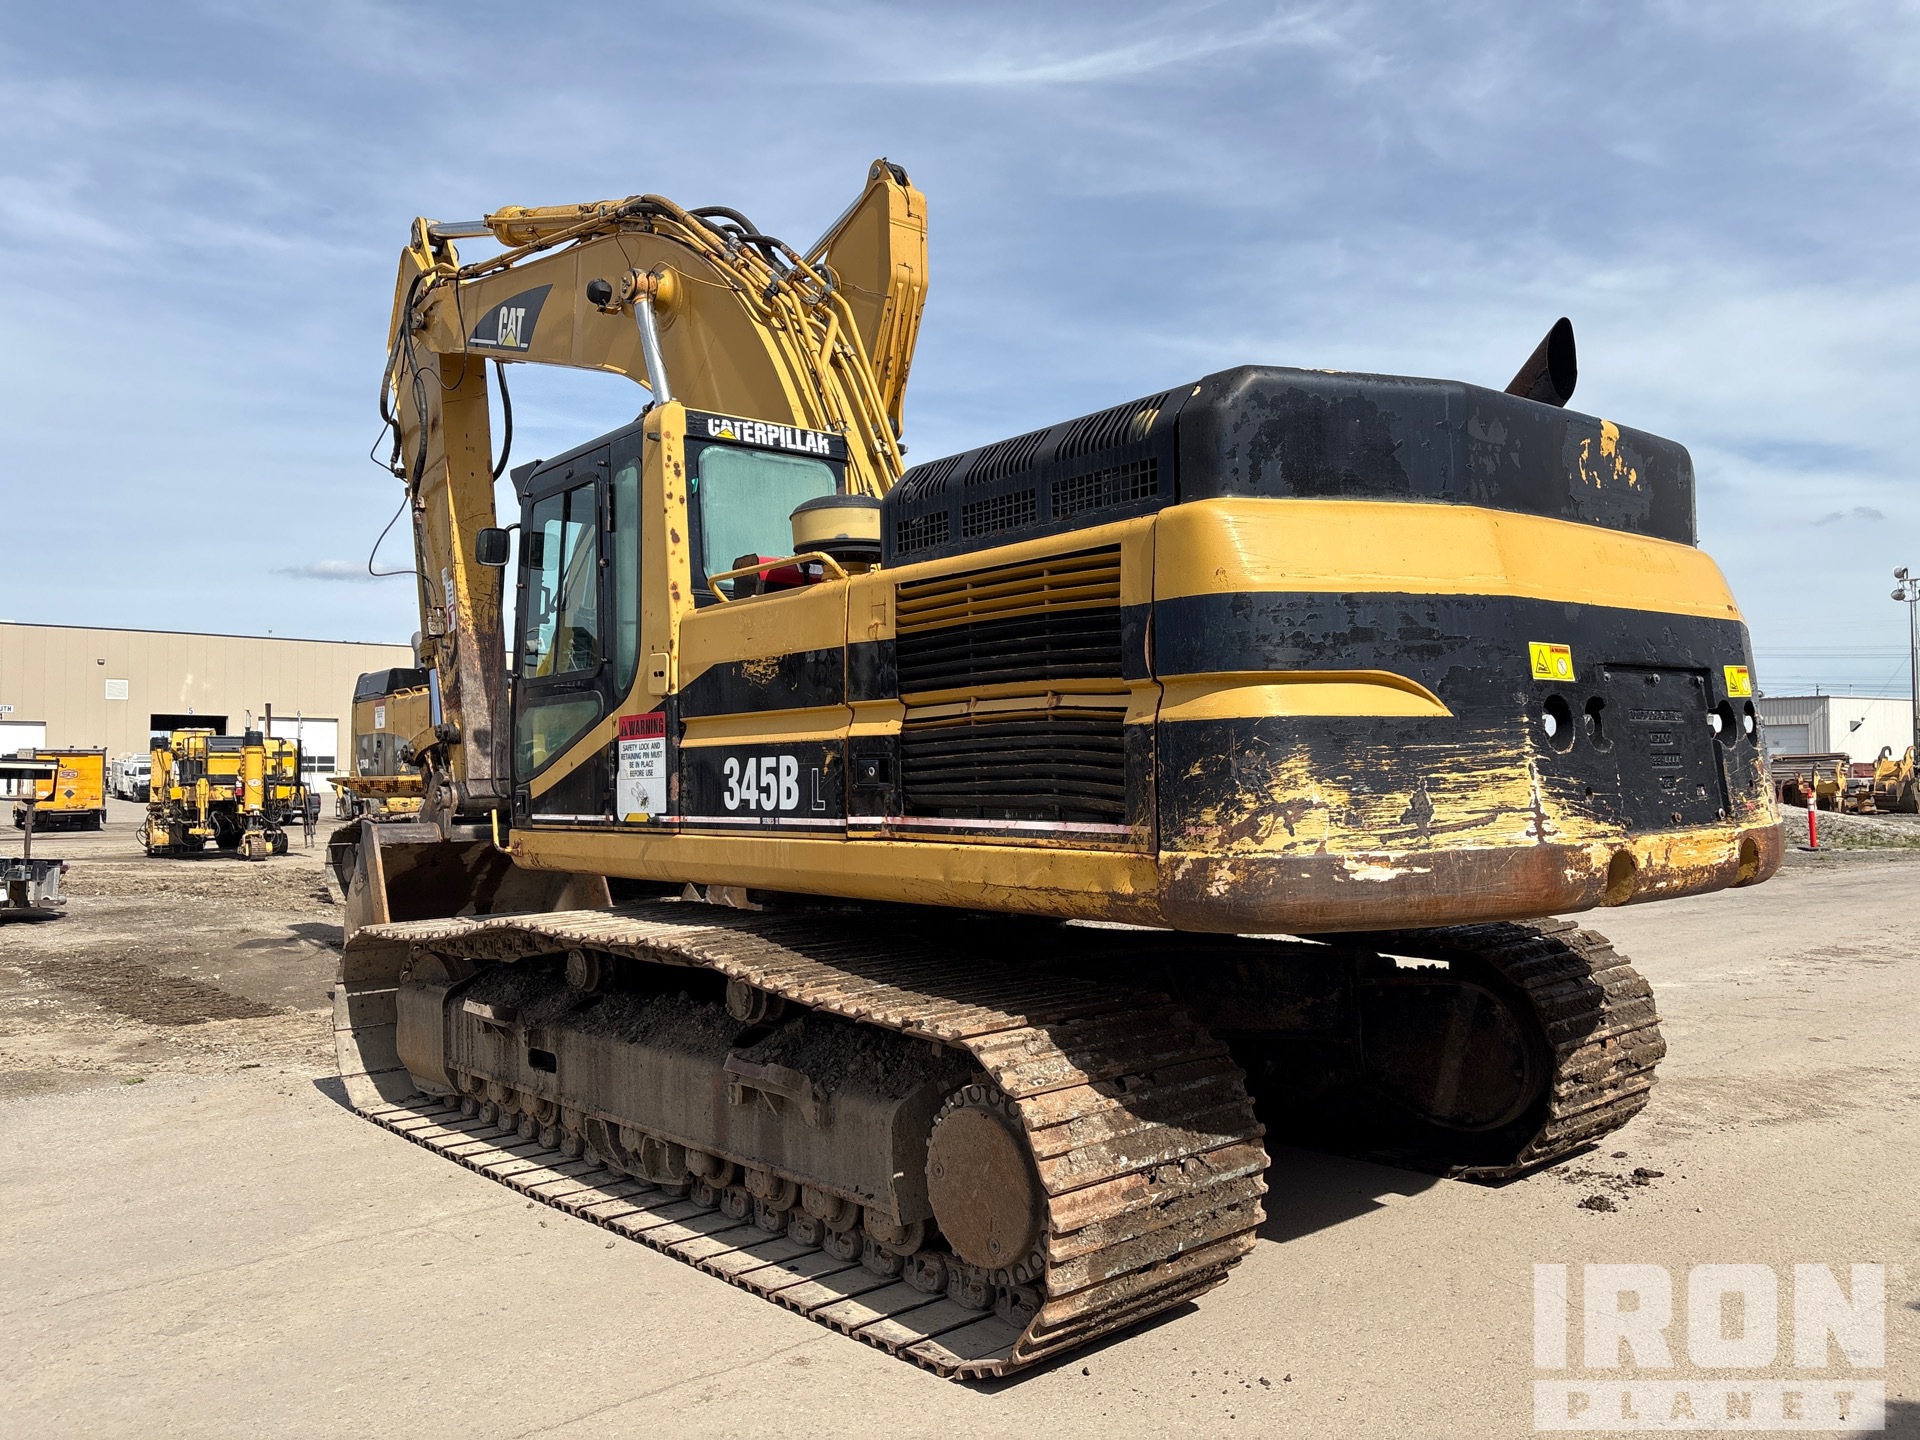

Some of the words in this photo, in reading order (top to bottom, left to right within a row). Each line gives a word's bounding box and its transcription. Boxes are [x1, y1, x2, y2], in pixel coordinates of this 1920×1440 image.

[497, 305, 526, 347] CAT
[707, 416, 831, 455] CATERPILLAR
[188, 707, 194, 715] 5
[628, 717, 664, 736] WARNING
[622, 743, 637, 752] SAFETY
[638, 743, 650, 751] LOCK
[651, 742, 661, 750] AND
[620, 752, 642, 760] RETAINING
[642, 751, 650, 759] PIN
[650, 750, 663, 758] MUST
[629, 761, 634, 769] BE
[640, 760, 654, 768] PLACE
[629, 769, 645, 777] BEFORE
[645, 769, 654, 777] USE
[723, 755, 800, 811] 345B
[811, 767, 826, 811] L
